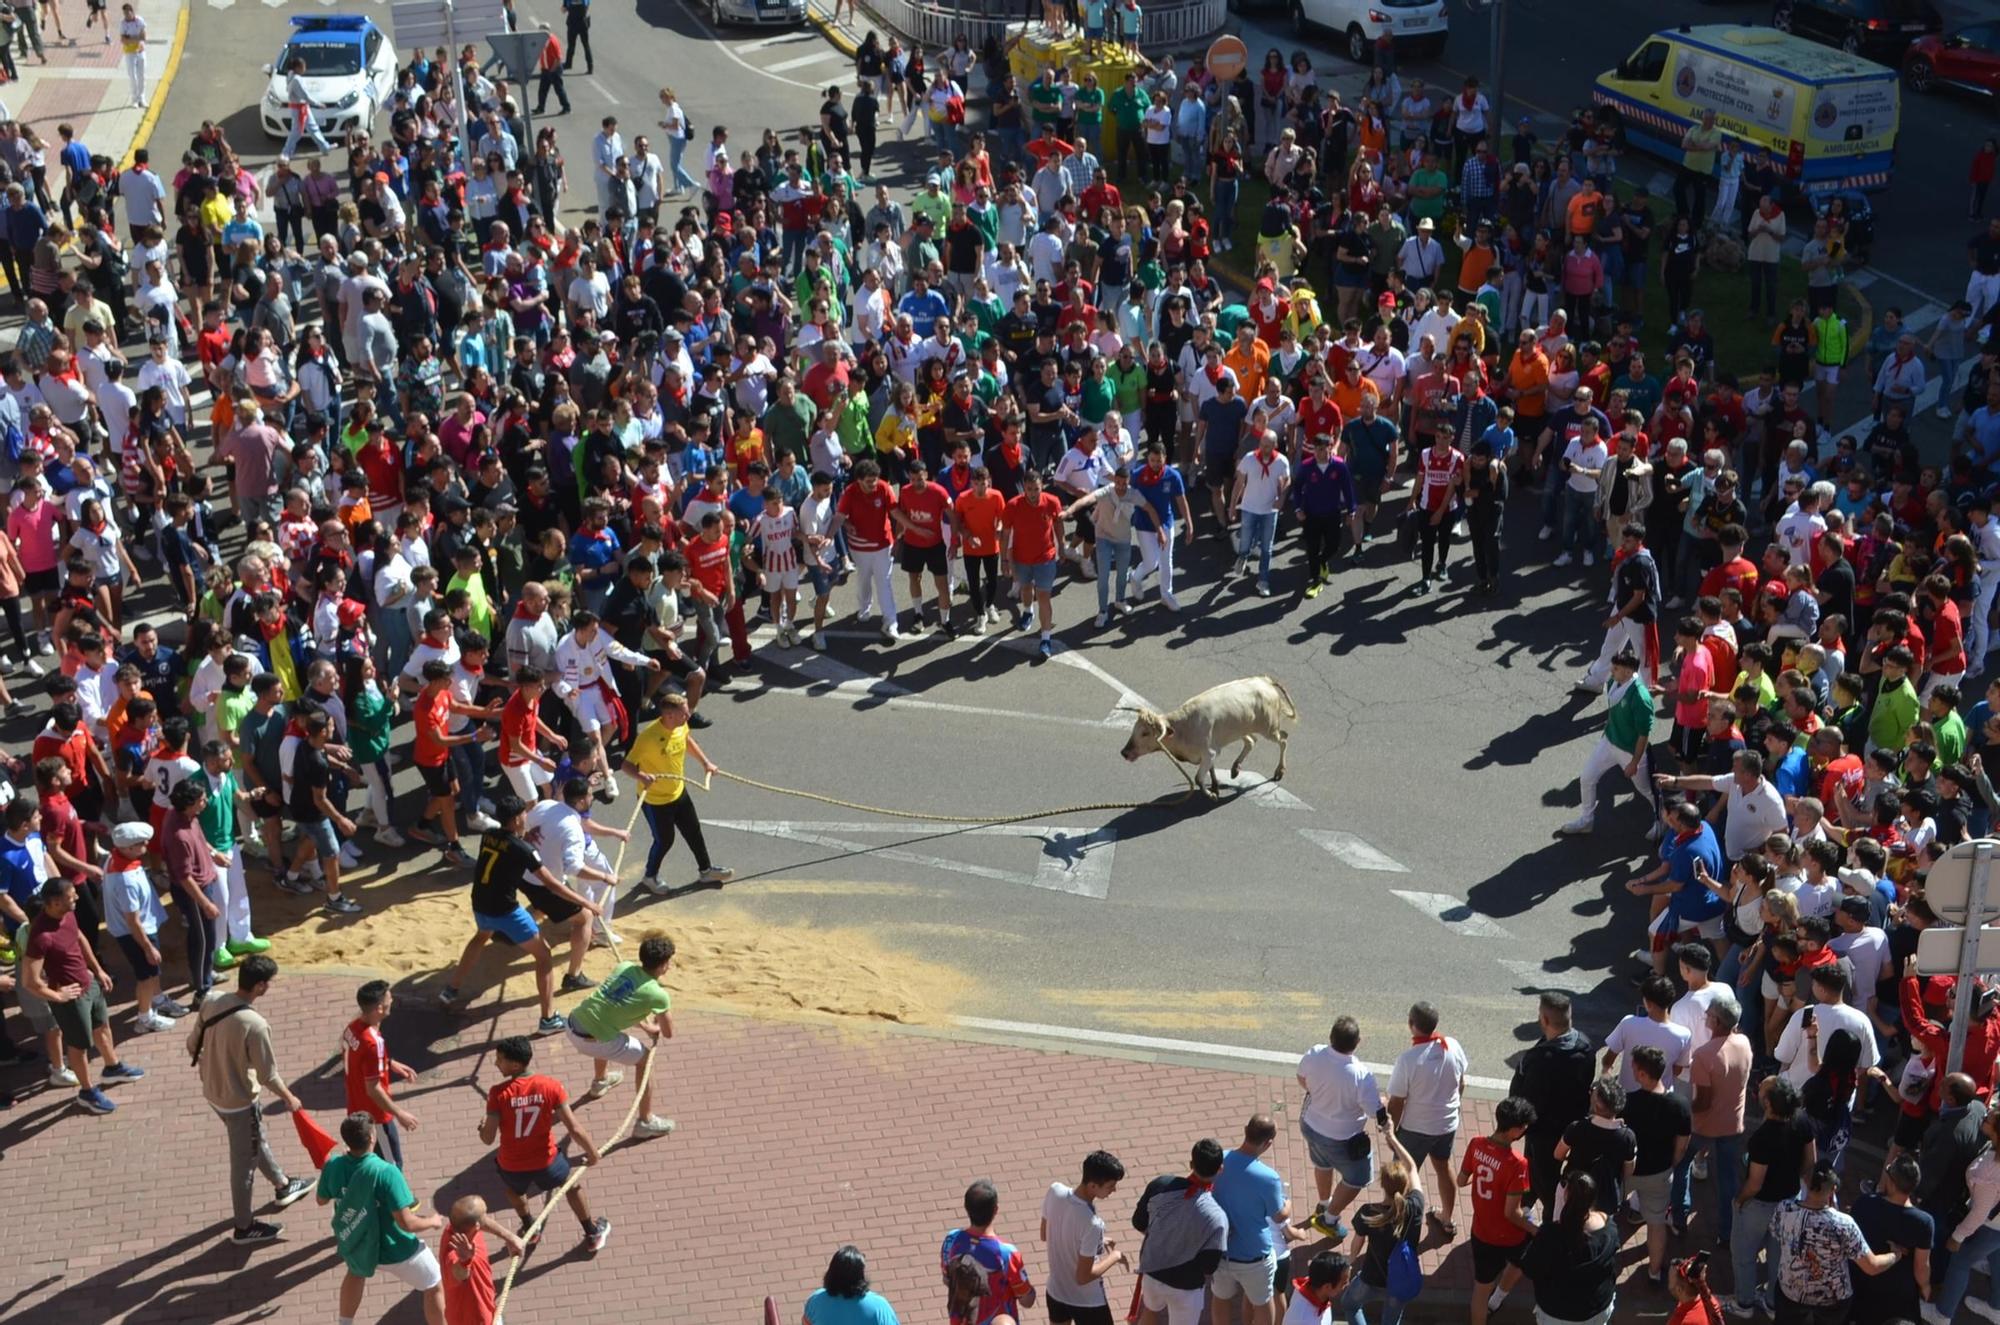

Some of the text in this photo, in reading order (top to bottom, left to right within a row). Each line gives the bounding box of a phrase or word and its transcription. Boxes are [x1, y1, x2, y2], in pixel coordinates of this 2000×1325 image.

[1736, 99, 1754, 113] CIVIL
[1772, 137, 1788, 151] 112
[1824, 139, 1880, 153] AMBULANCIA
[158, 766, 169, 796] 3
[481, 847, 499, 885] 7
[515, 1105, 541, 1138] 17
[1473, 1149, 1502, 1171] HAKIMI
[1476, 1164, 1494, 1200] 2
